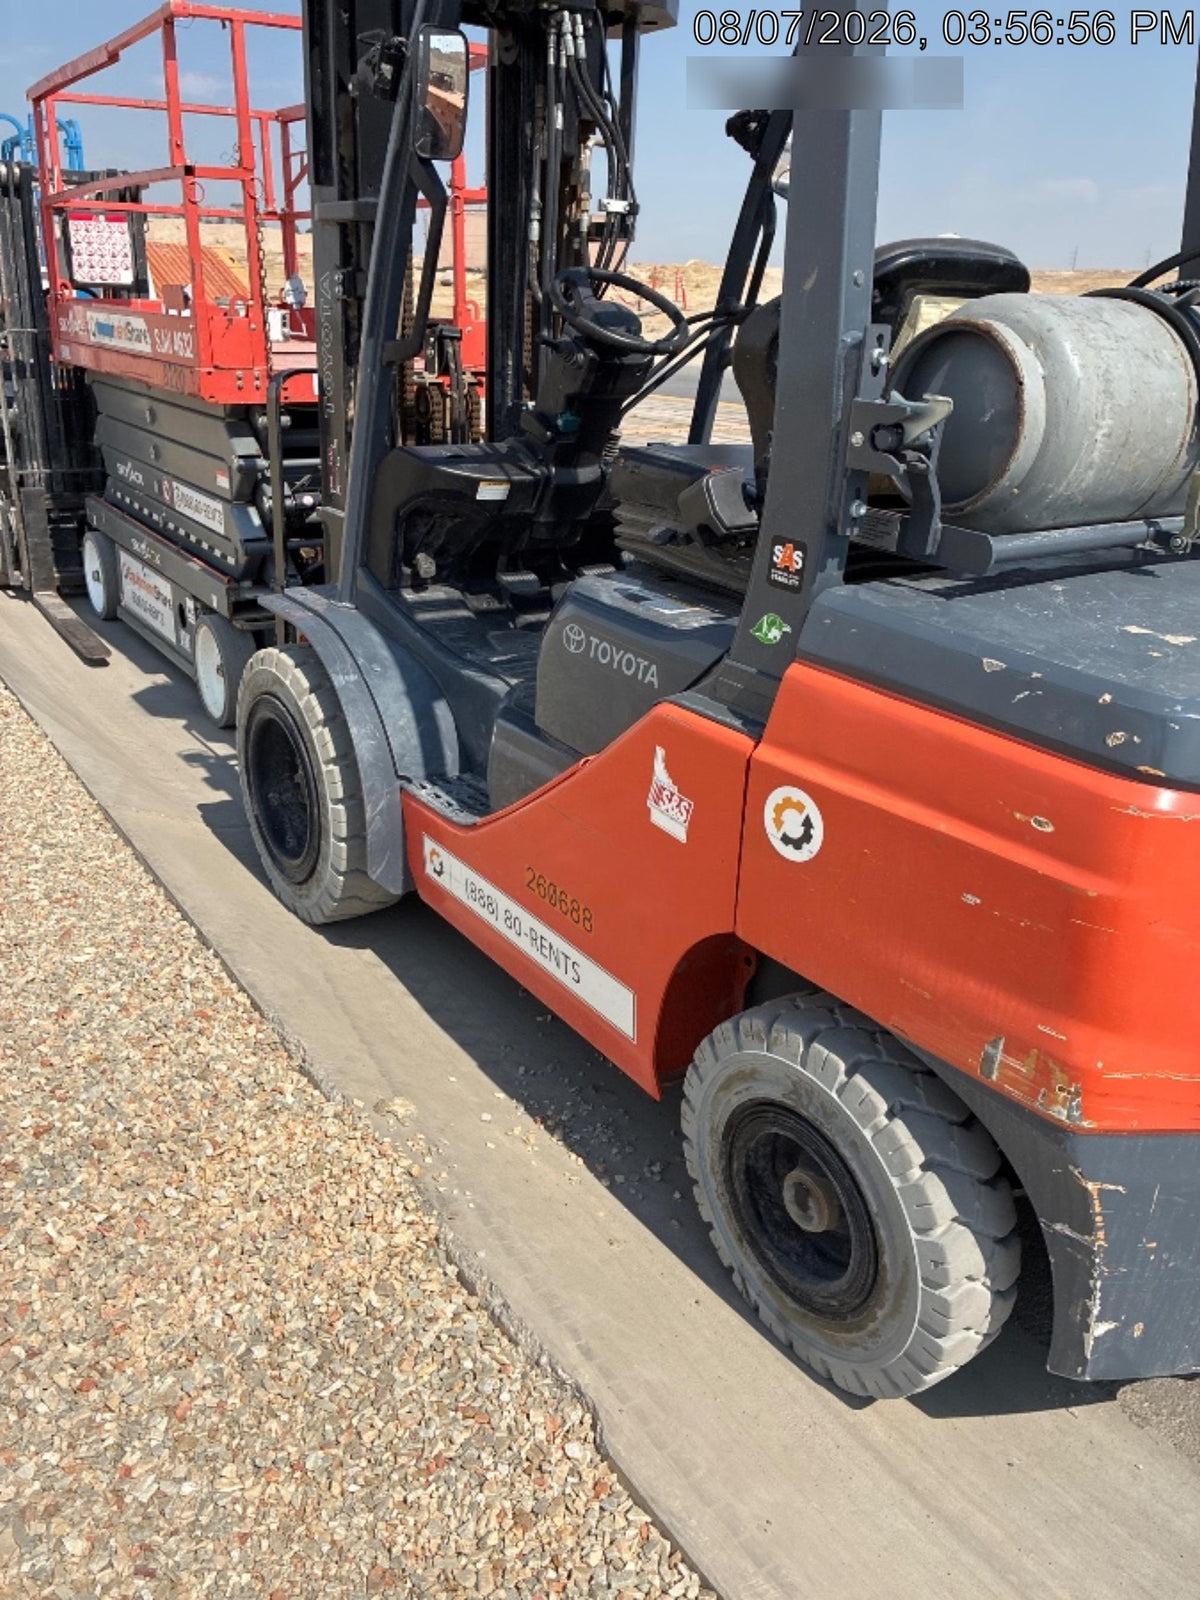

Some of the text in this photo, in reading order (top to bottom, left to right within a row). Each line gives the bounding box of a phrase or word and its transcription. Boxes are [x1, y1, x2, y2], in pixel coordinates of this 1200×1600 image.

[319, 271, 335, 418] TOYOTA
[773, 543, 804, 572] SAS
[589, 636, 659, 689] TOYOTA
[660, 789, 690, 824] S&S
[465, 877, 581, 984] (888) 80-RENTS
[525, 867, 593, 934] 260688
